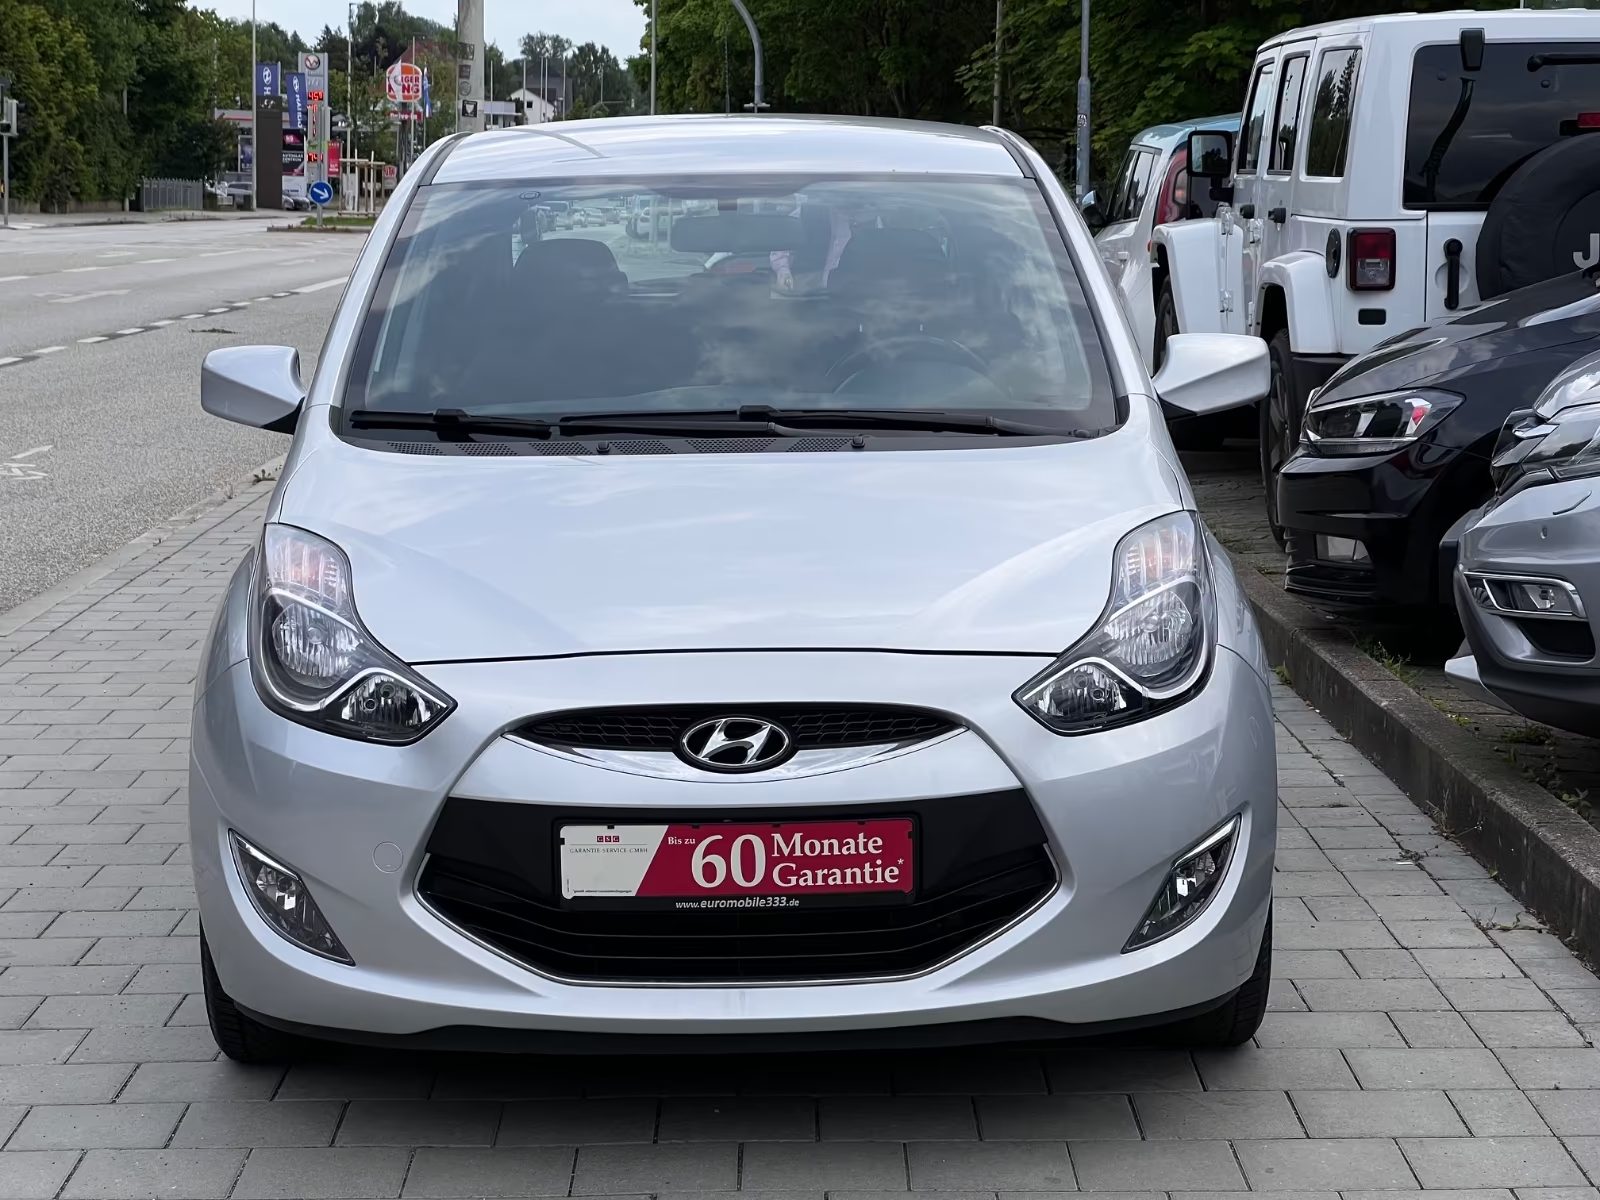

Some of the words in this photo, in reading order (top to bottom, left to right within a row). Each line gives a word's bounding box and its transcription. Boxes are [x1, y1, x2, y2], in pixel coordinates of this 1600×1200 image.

[771, 832, 883, 857] Monate
[667, 836, 682, 845] Bis
[684, 837, 696, 845] zu
[691, 834, 766, 888] 60
[675, 896, 800, 910] www.euromobile333.de
